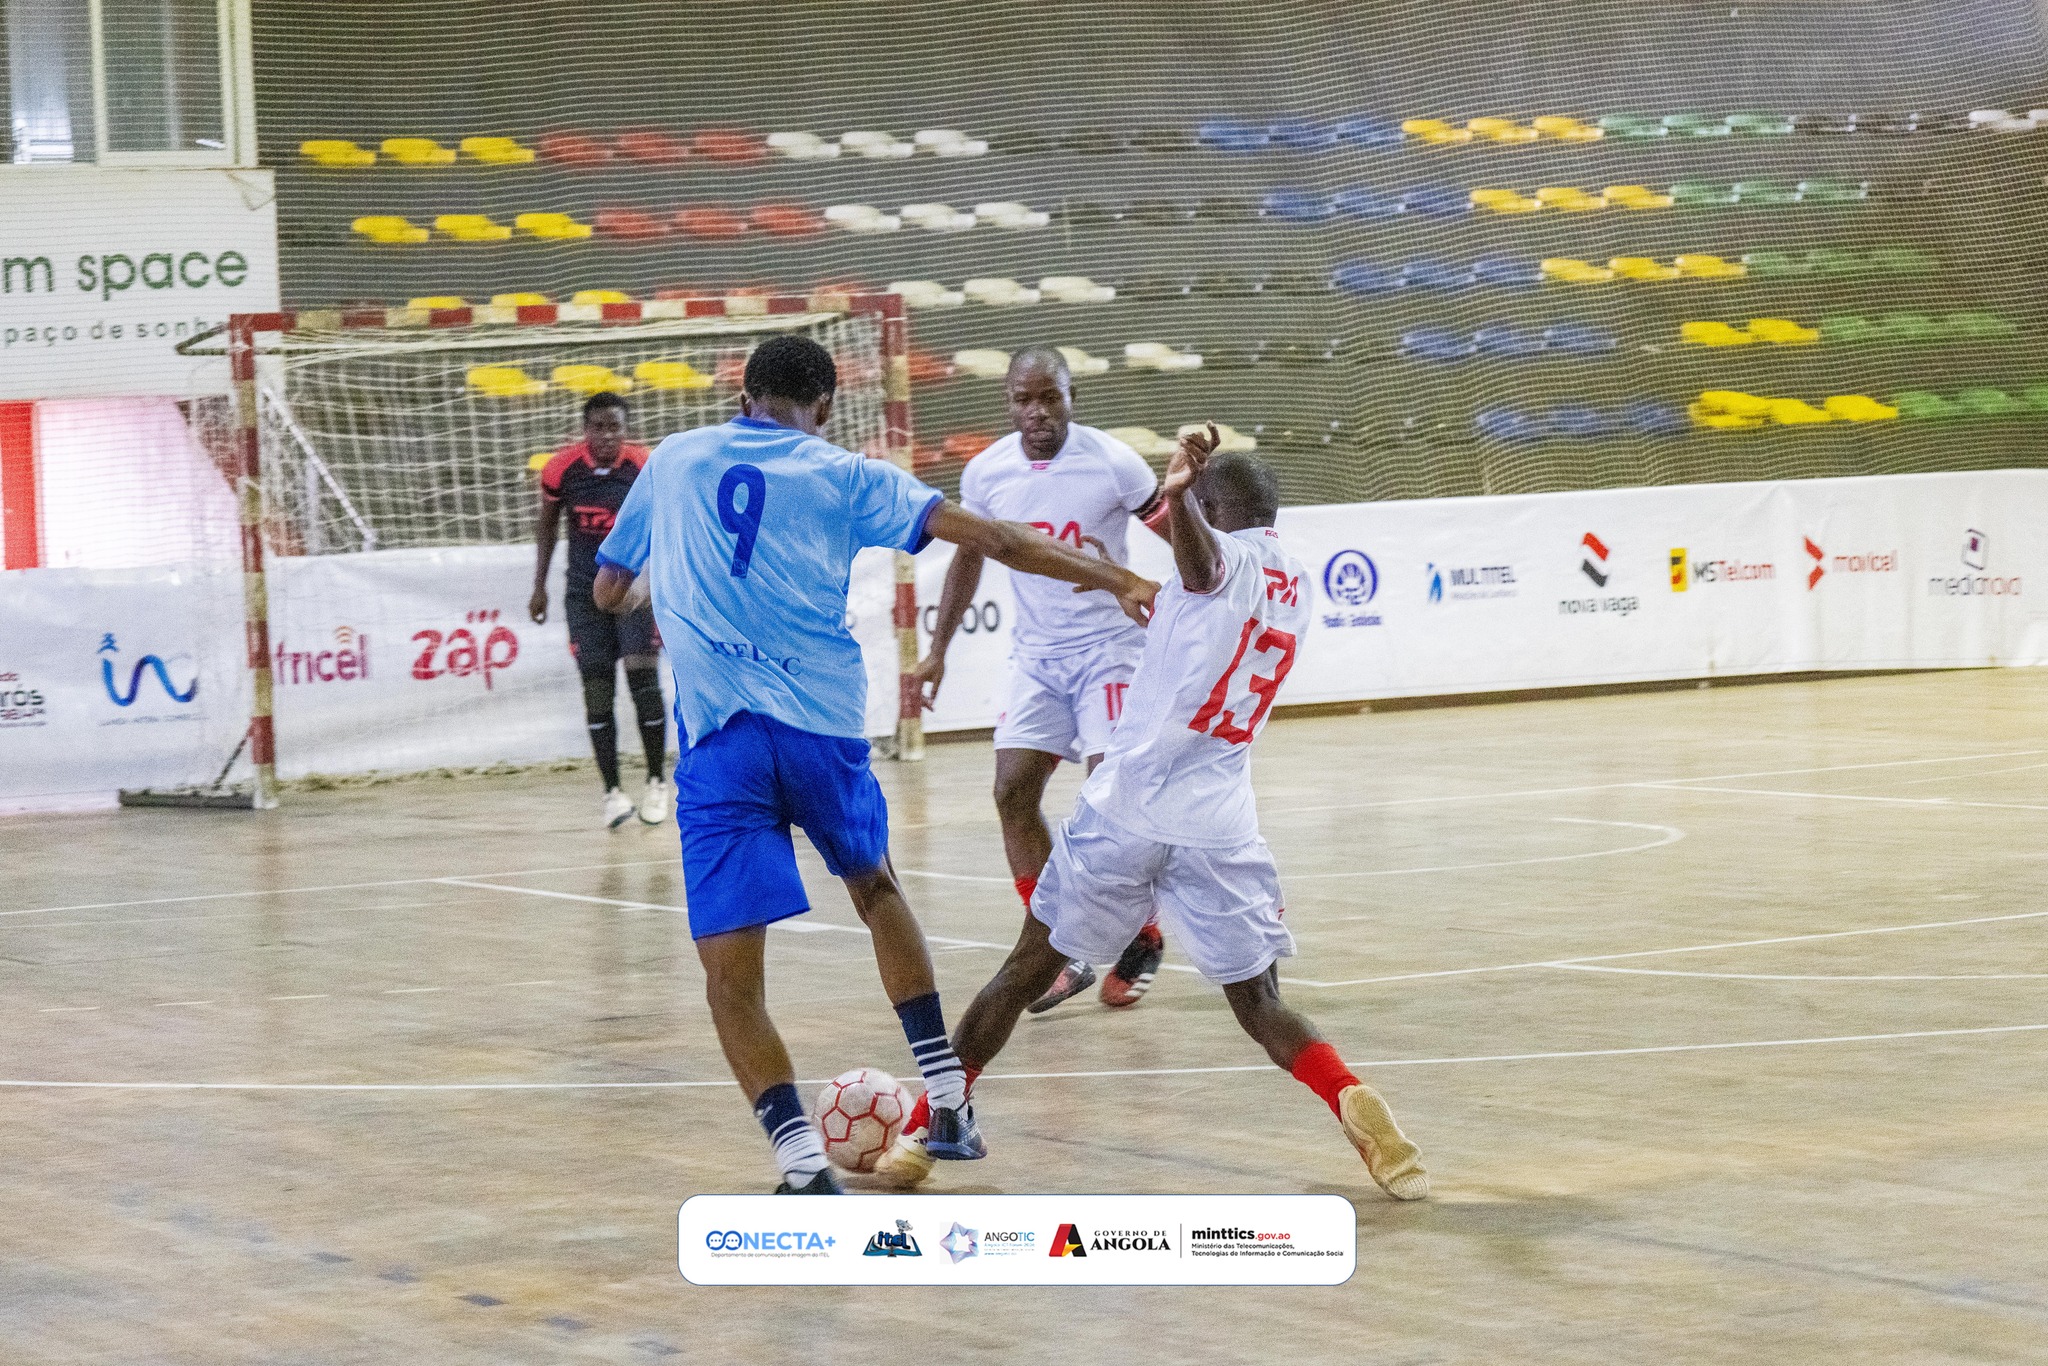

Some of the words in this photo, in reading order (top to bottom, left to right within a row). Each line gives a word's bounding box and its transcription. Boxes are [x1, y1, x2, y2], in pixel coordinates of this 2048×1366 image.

[77, 250, 248, 301] space
[90, 319, 124, 339] de
[717, 464, 766, 579] 9
[1187, 617, 1297, 746] 13
